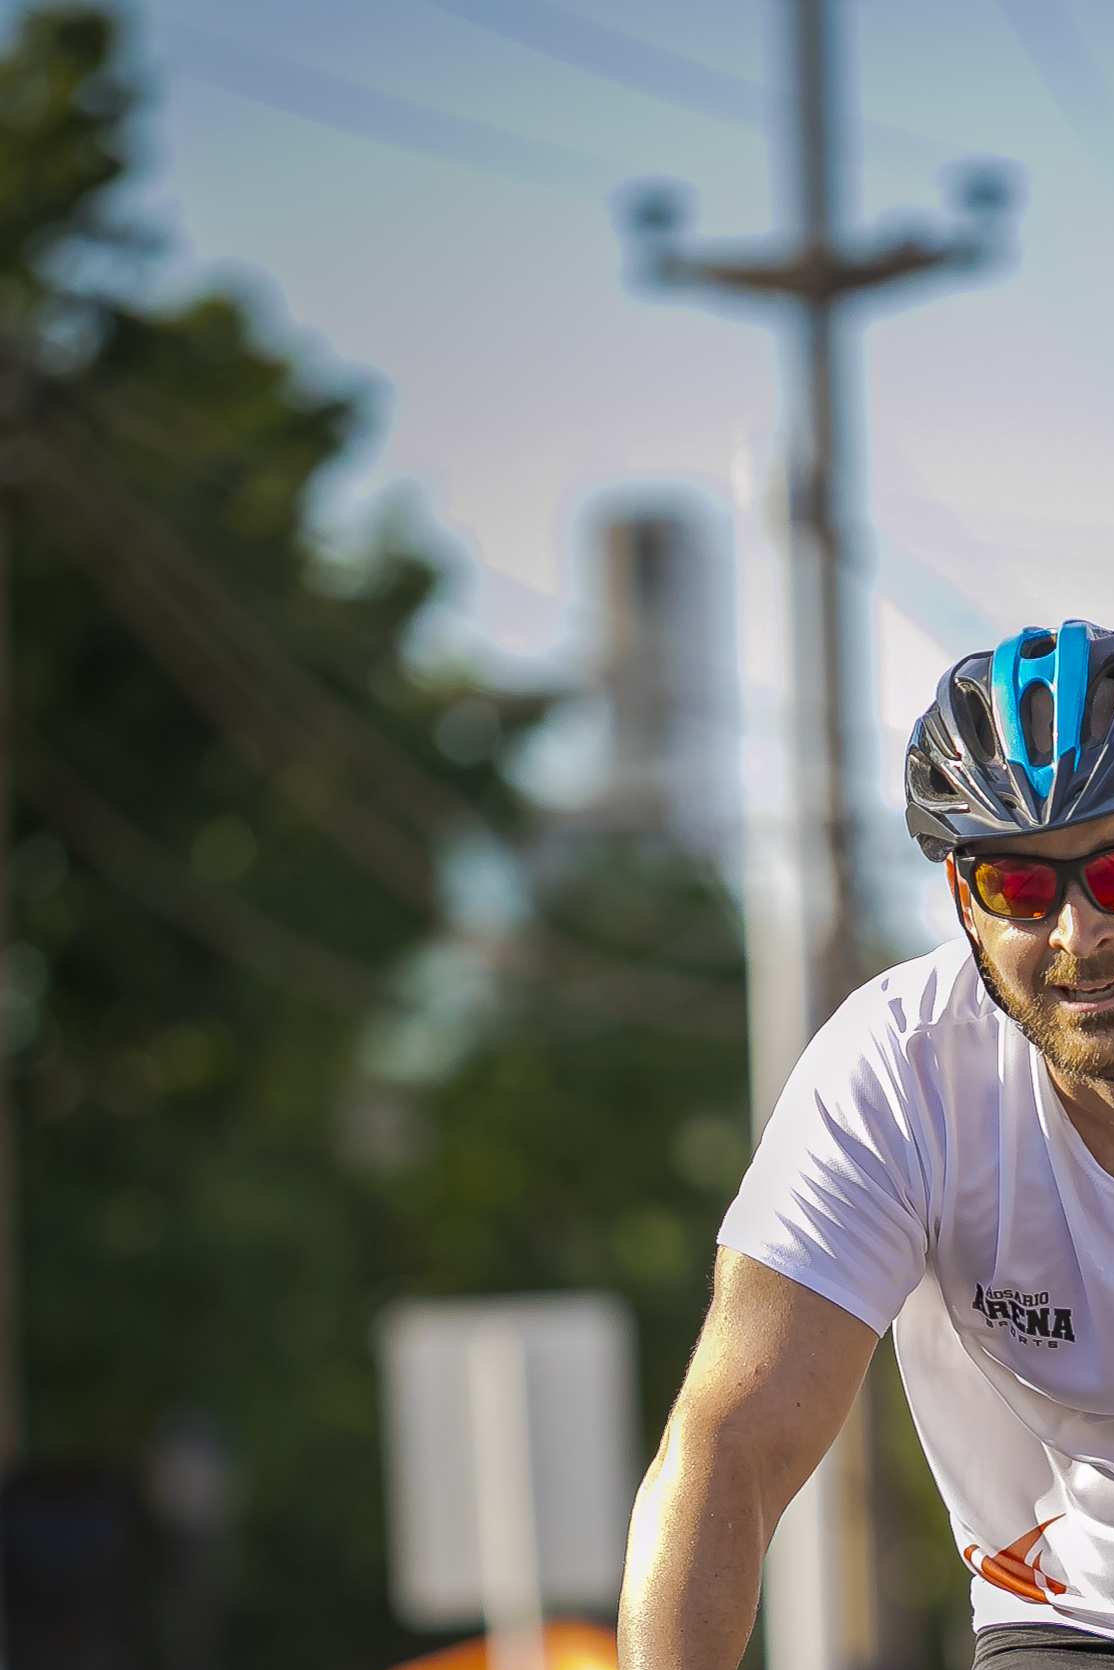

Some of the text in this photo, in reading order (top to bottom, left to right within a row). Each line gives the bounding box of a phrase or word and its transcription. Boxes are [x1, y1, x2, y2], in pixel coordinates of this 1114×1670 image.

[985, 1286, 1049, 1307] ROSARIO
[972, 1282, 1076, 1343] ARENA
[985, 1318, 1058, 1349] SPORTS
